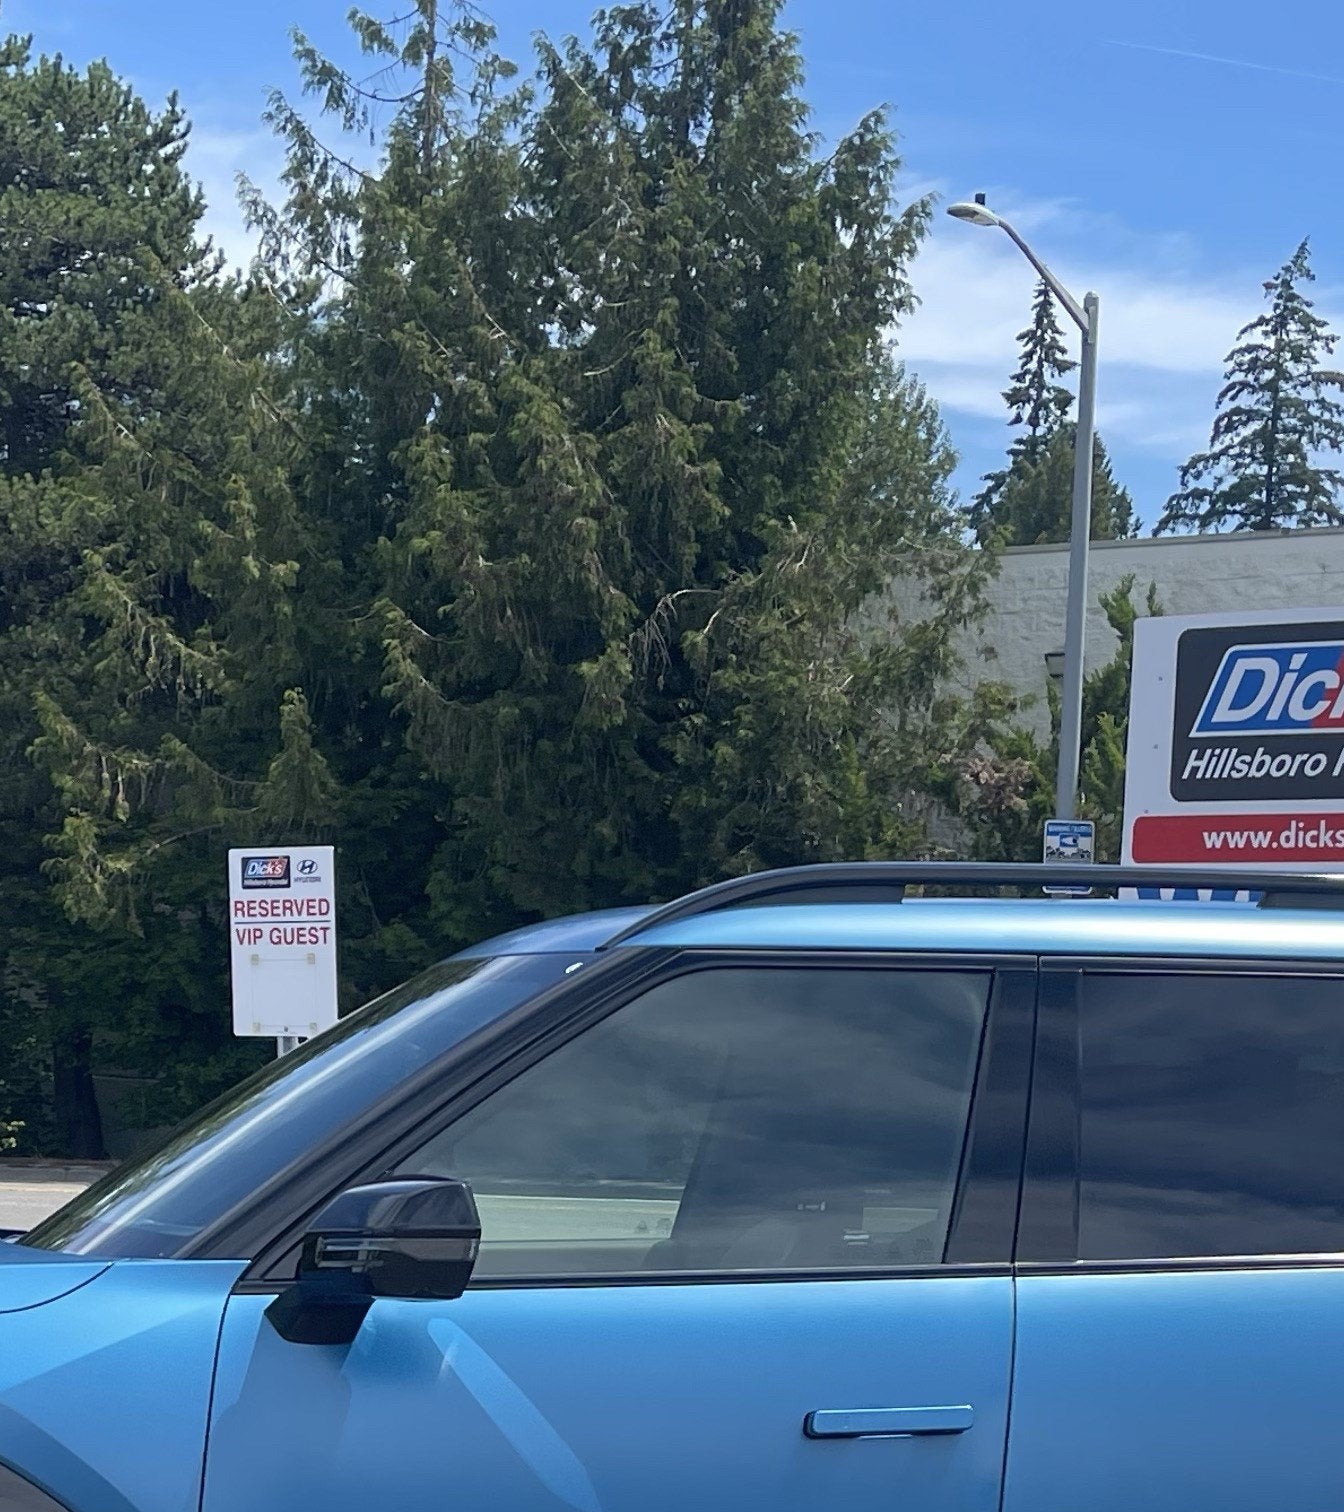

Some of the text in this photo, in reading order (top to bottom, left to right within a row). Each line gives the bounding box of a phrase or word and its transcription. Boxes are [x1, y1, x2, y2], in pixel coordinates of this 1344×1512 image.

[1181, 746, 1328, 780] Hillsboro
[234, 898, 330, 918] RESERVED
[235, 927, 331, 945] VIP GUEST
